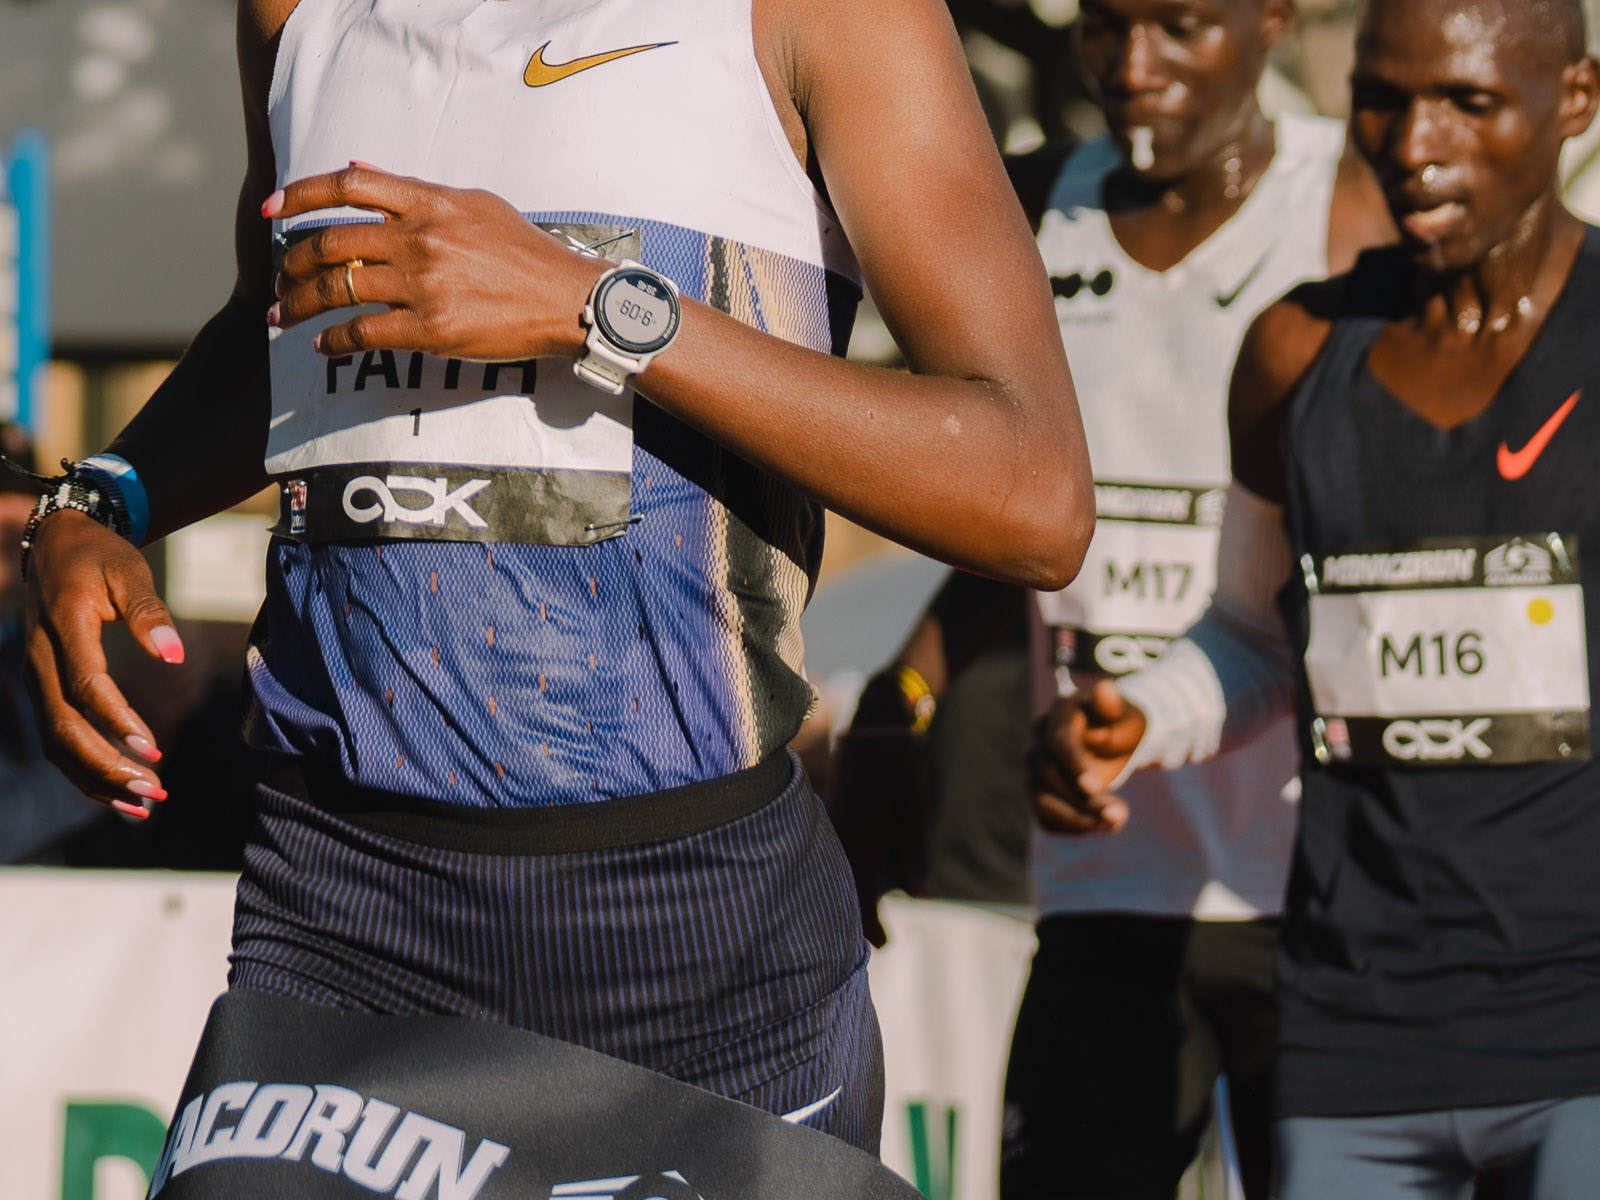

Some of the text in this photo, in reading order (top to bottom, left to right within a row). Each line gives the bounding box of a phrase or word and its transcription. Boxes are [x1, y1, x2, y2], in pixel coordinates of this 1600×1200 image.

[409, 408, 422, 437] 1
[1104, 560, 1193, 601] M17
[1380, 631, 1486, 678] M16
